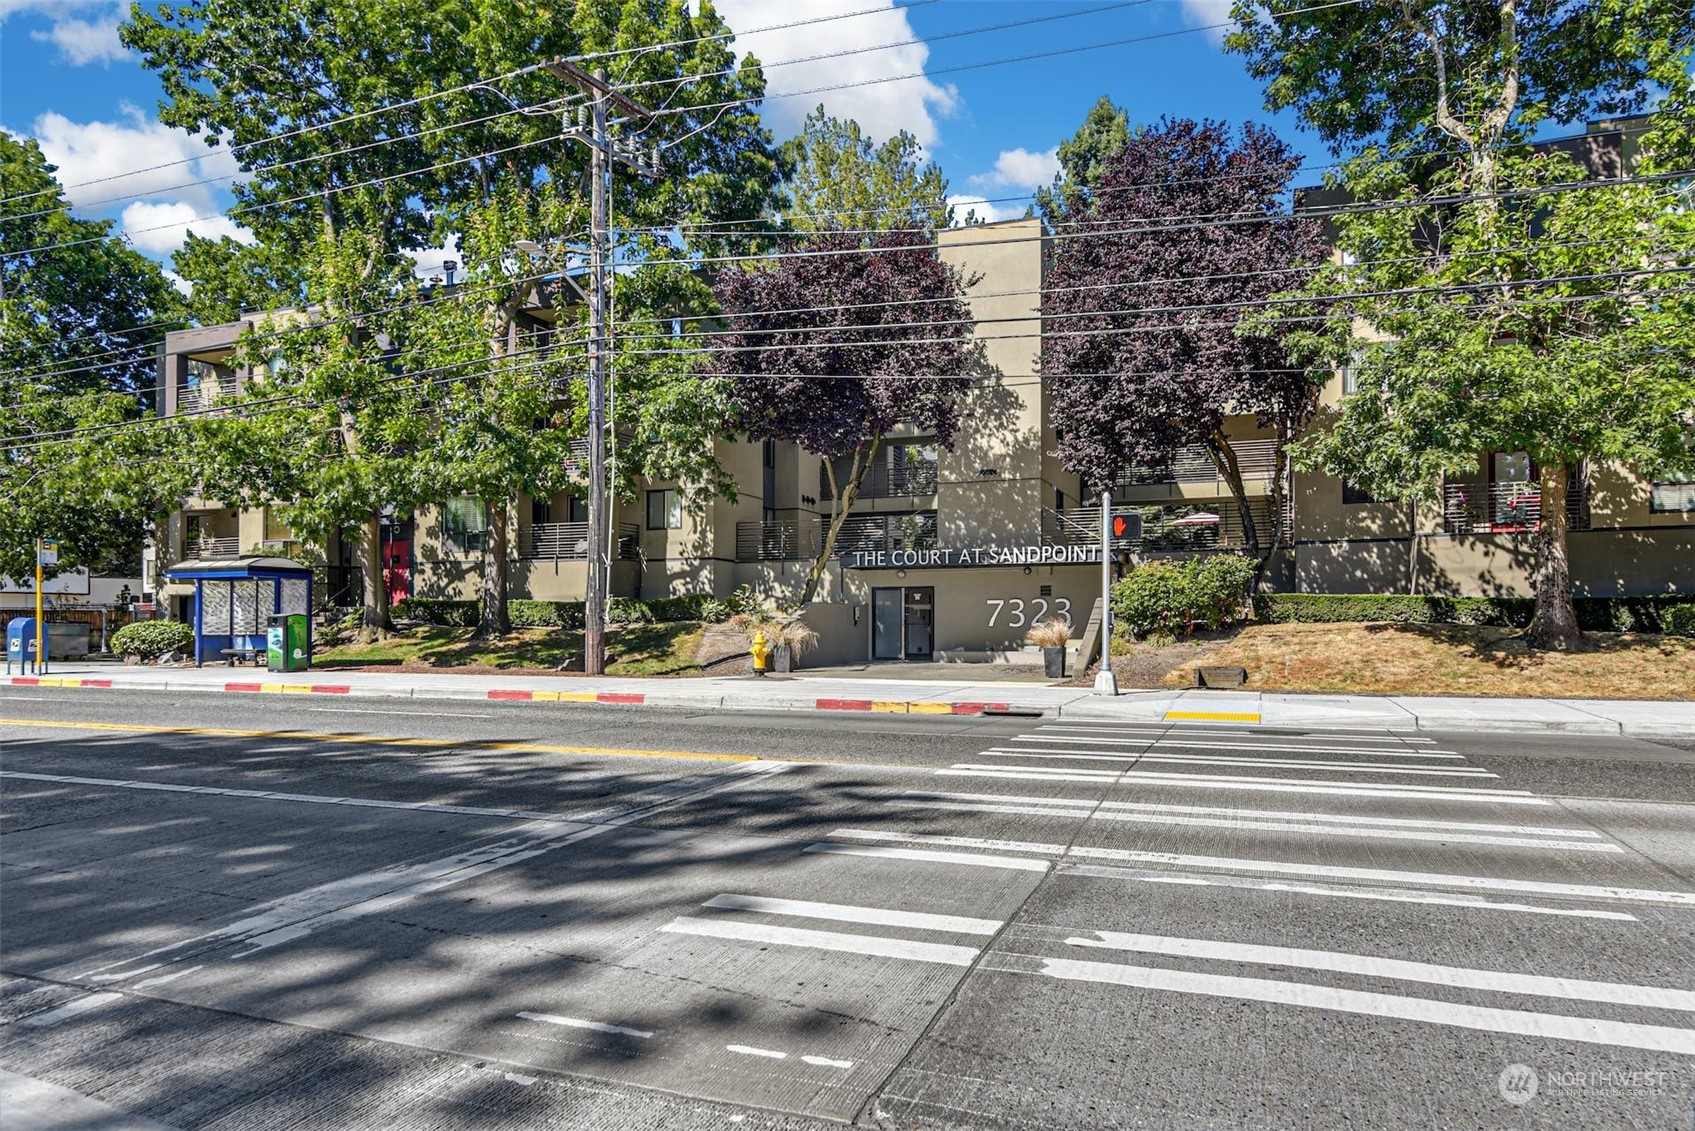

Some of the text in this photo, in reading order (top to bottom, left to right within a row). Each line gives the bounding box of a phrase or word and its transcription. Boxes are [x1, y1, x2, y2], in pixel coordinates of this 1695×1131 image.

[852, 545, 1101, 566] THE COURT AT SANDPOINT
[986, 598, 1072, 628] 7323
